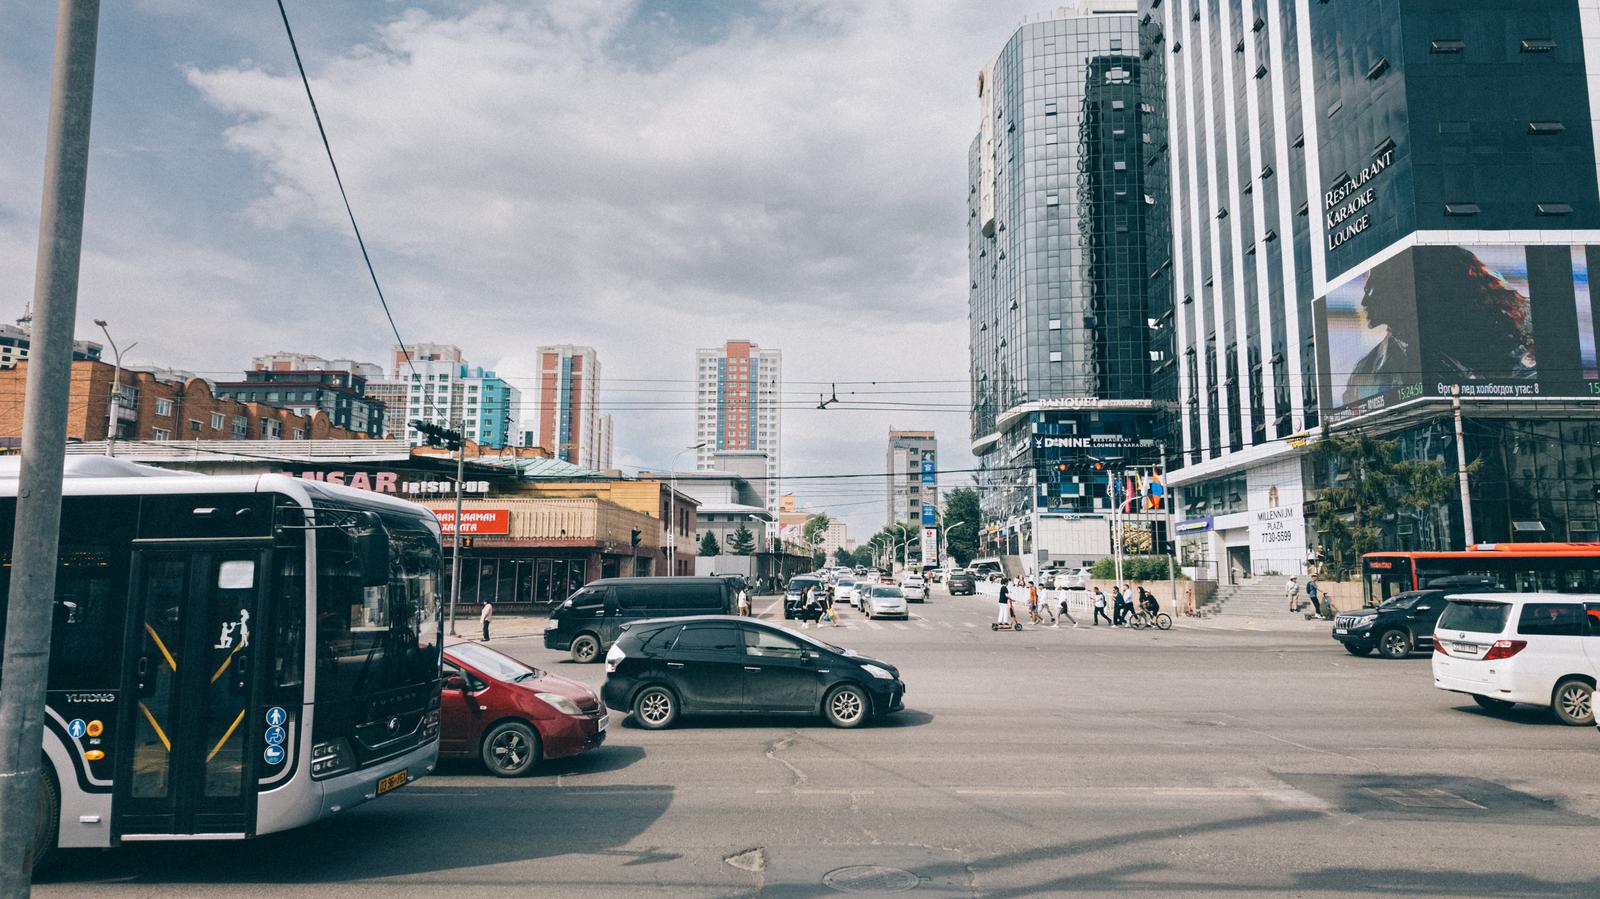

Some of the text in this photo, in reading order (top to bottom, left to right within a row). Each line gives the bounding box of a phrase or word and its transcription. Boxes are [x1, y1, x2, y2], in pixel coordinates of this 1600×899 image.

[1325, 150, 1392, 210] RESTAURANT
[1326, 188, 1374, 230] KARAOKE
[1328, 214, 1369, 251] LOUNGE
[1461, 385, 1475, 395] лед
[1476, 383, 1513, 395] холбогдох
[1534, 383, 1540, 394] 8
[1040, 397, 1099, 409] BANQUET
[282, 471, 399, 493] SAR
[402, 481, 450, 493] IRISH
[459, 513, 496, 522] ААМАН
[1257, 508, 1294, 521] MILLENNIUM
[442, 523, 477, 532] ХАЛГА
[1267, 521, 1284, 531] PLAZA
[1261, 530, 1292, 543] 7730-5599
[66, 693, 116, 703] YUTONG
